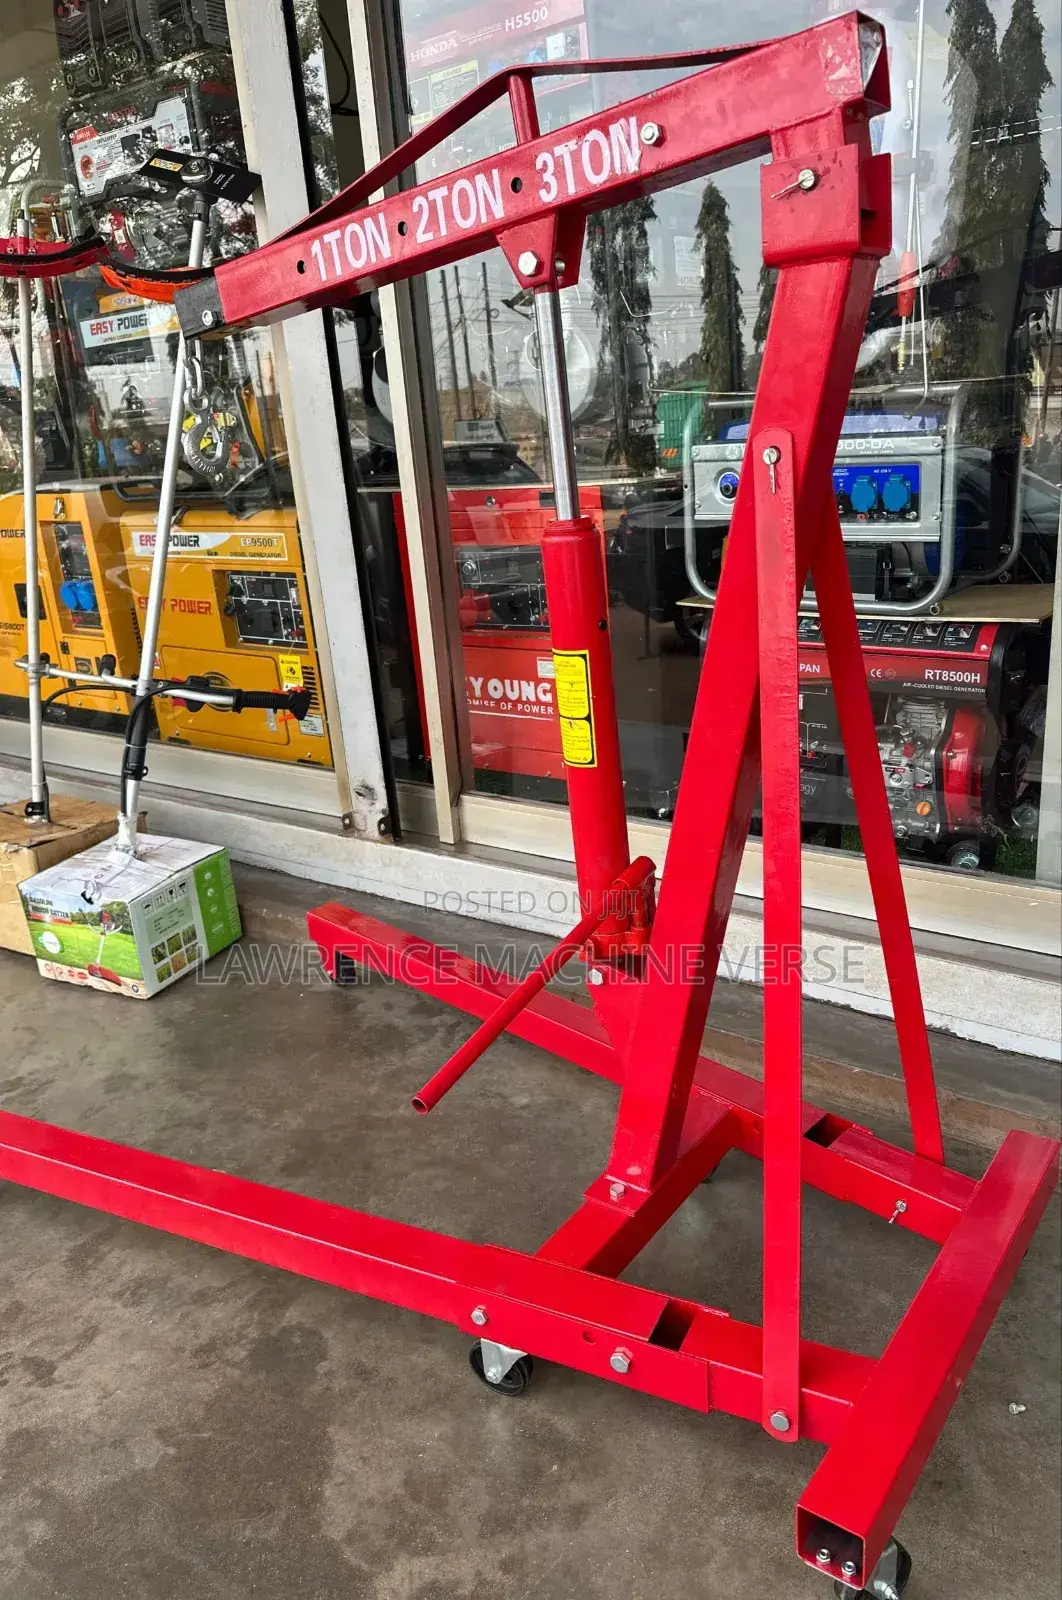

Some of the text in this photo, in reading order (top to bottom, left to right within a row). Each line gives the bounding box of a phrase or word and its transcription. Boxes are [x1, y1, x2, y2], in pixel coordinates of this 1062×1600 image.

[410, 38, 458, 62] HONDA
[310, 116, 643, 282] 1TON 2TON 3TON
[89, 320, 115, 336] EASY
[0, 529, 25, 538] OWER
[139, 534, 200, 548] EAS POWER
[170, 598, 213, 615] POWER
[799, 663, 820, 674] PAN
[924, 669, 981, 684] RT8500H
[935, 684, 953, 692] DIESEL
[953, 686, 986, 694] GENERATOR
[500, 702, 513, 711] OF
[517, 703, 554, 715] POWER
